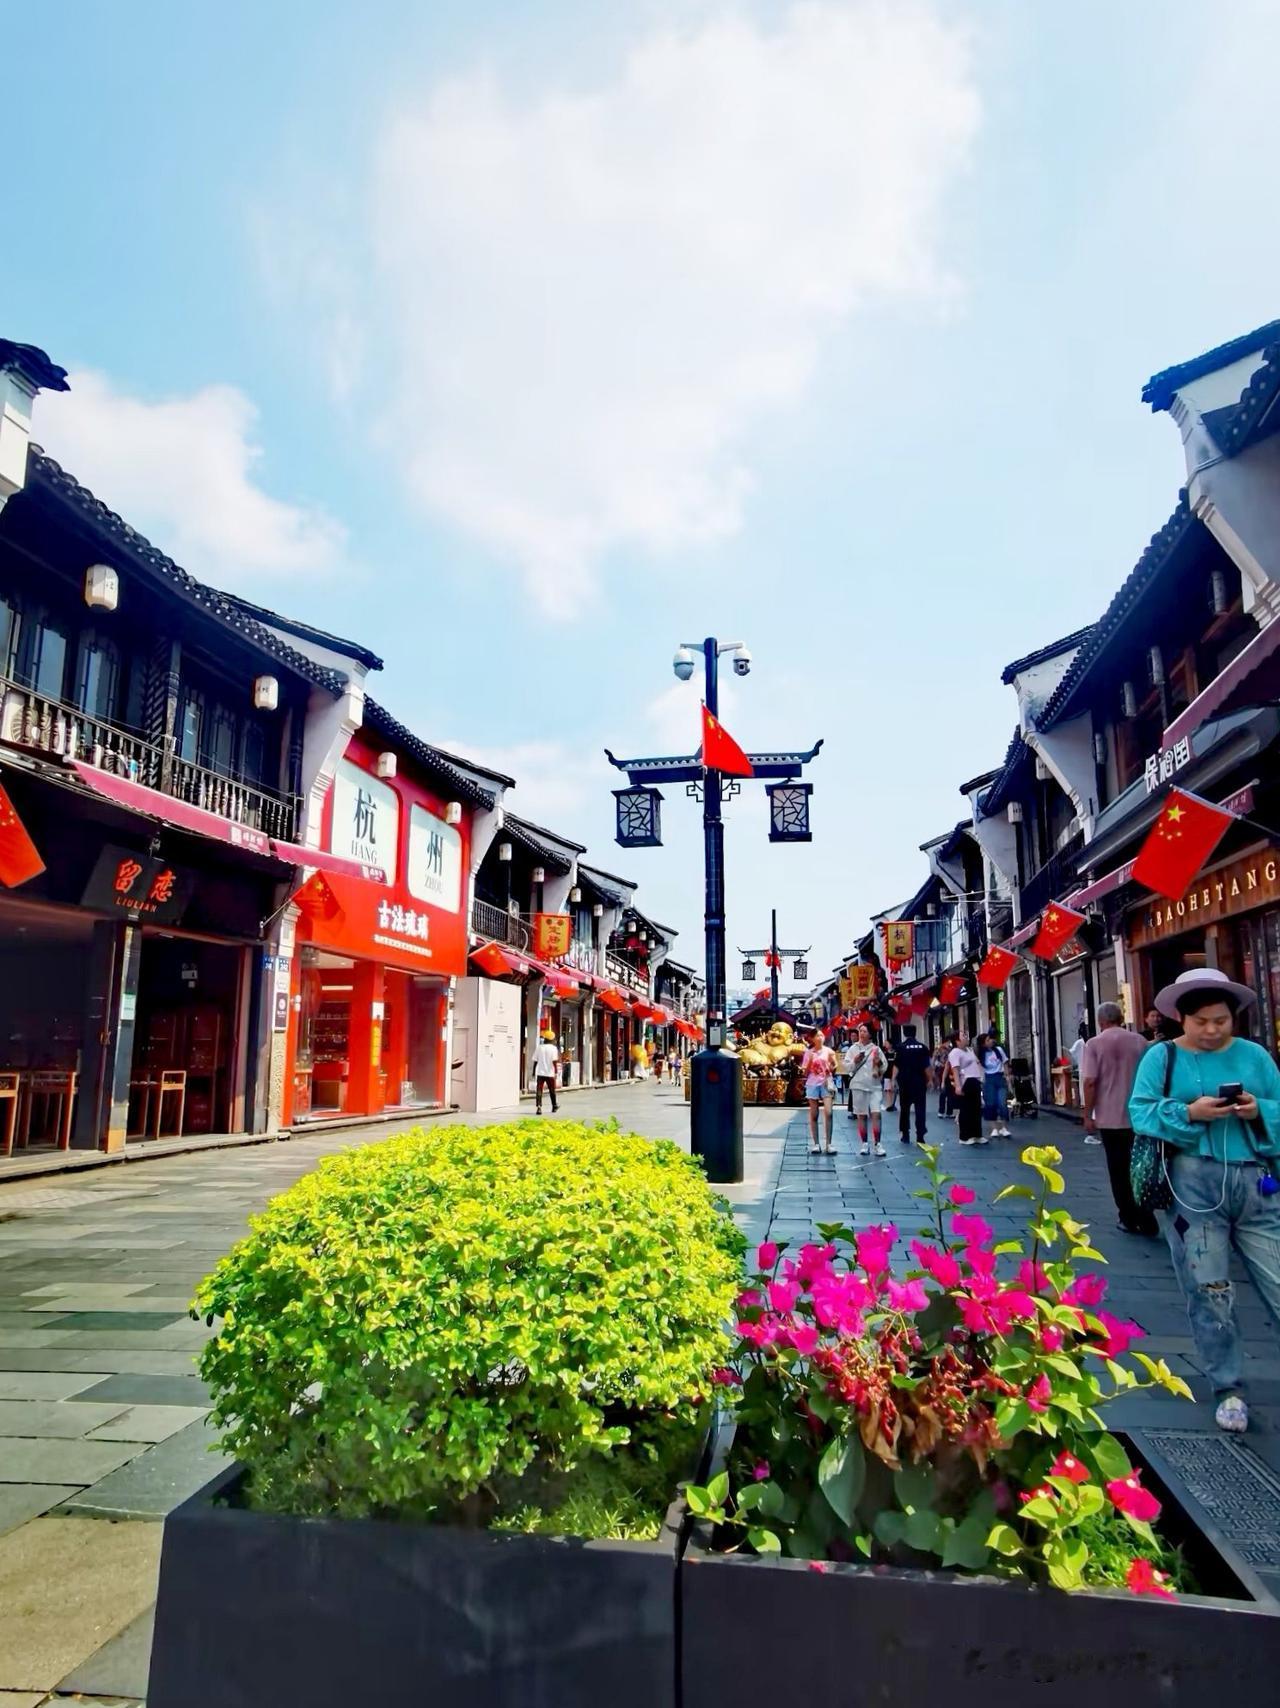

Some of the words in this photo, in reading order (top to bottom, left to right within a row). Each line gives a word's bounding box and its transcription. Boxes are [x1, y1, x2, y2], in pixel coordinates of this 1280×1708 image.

[353, 788, 377, 845] 杭
[351, 840, 378, 865] HANG
[426, 831, 443, 877] 州
[114, 858, 176, 903] 留恋
[1156, 861, 1276, 927] BAOHETANG
[116, 896, 158, 913] LIULIAN
